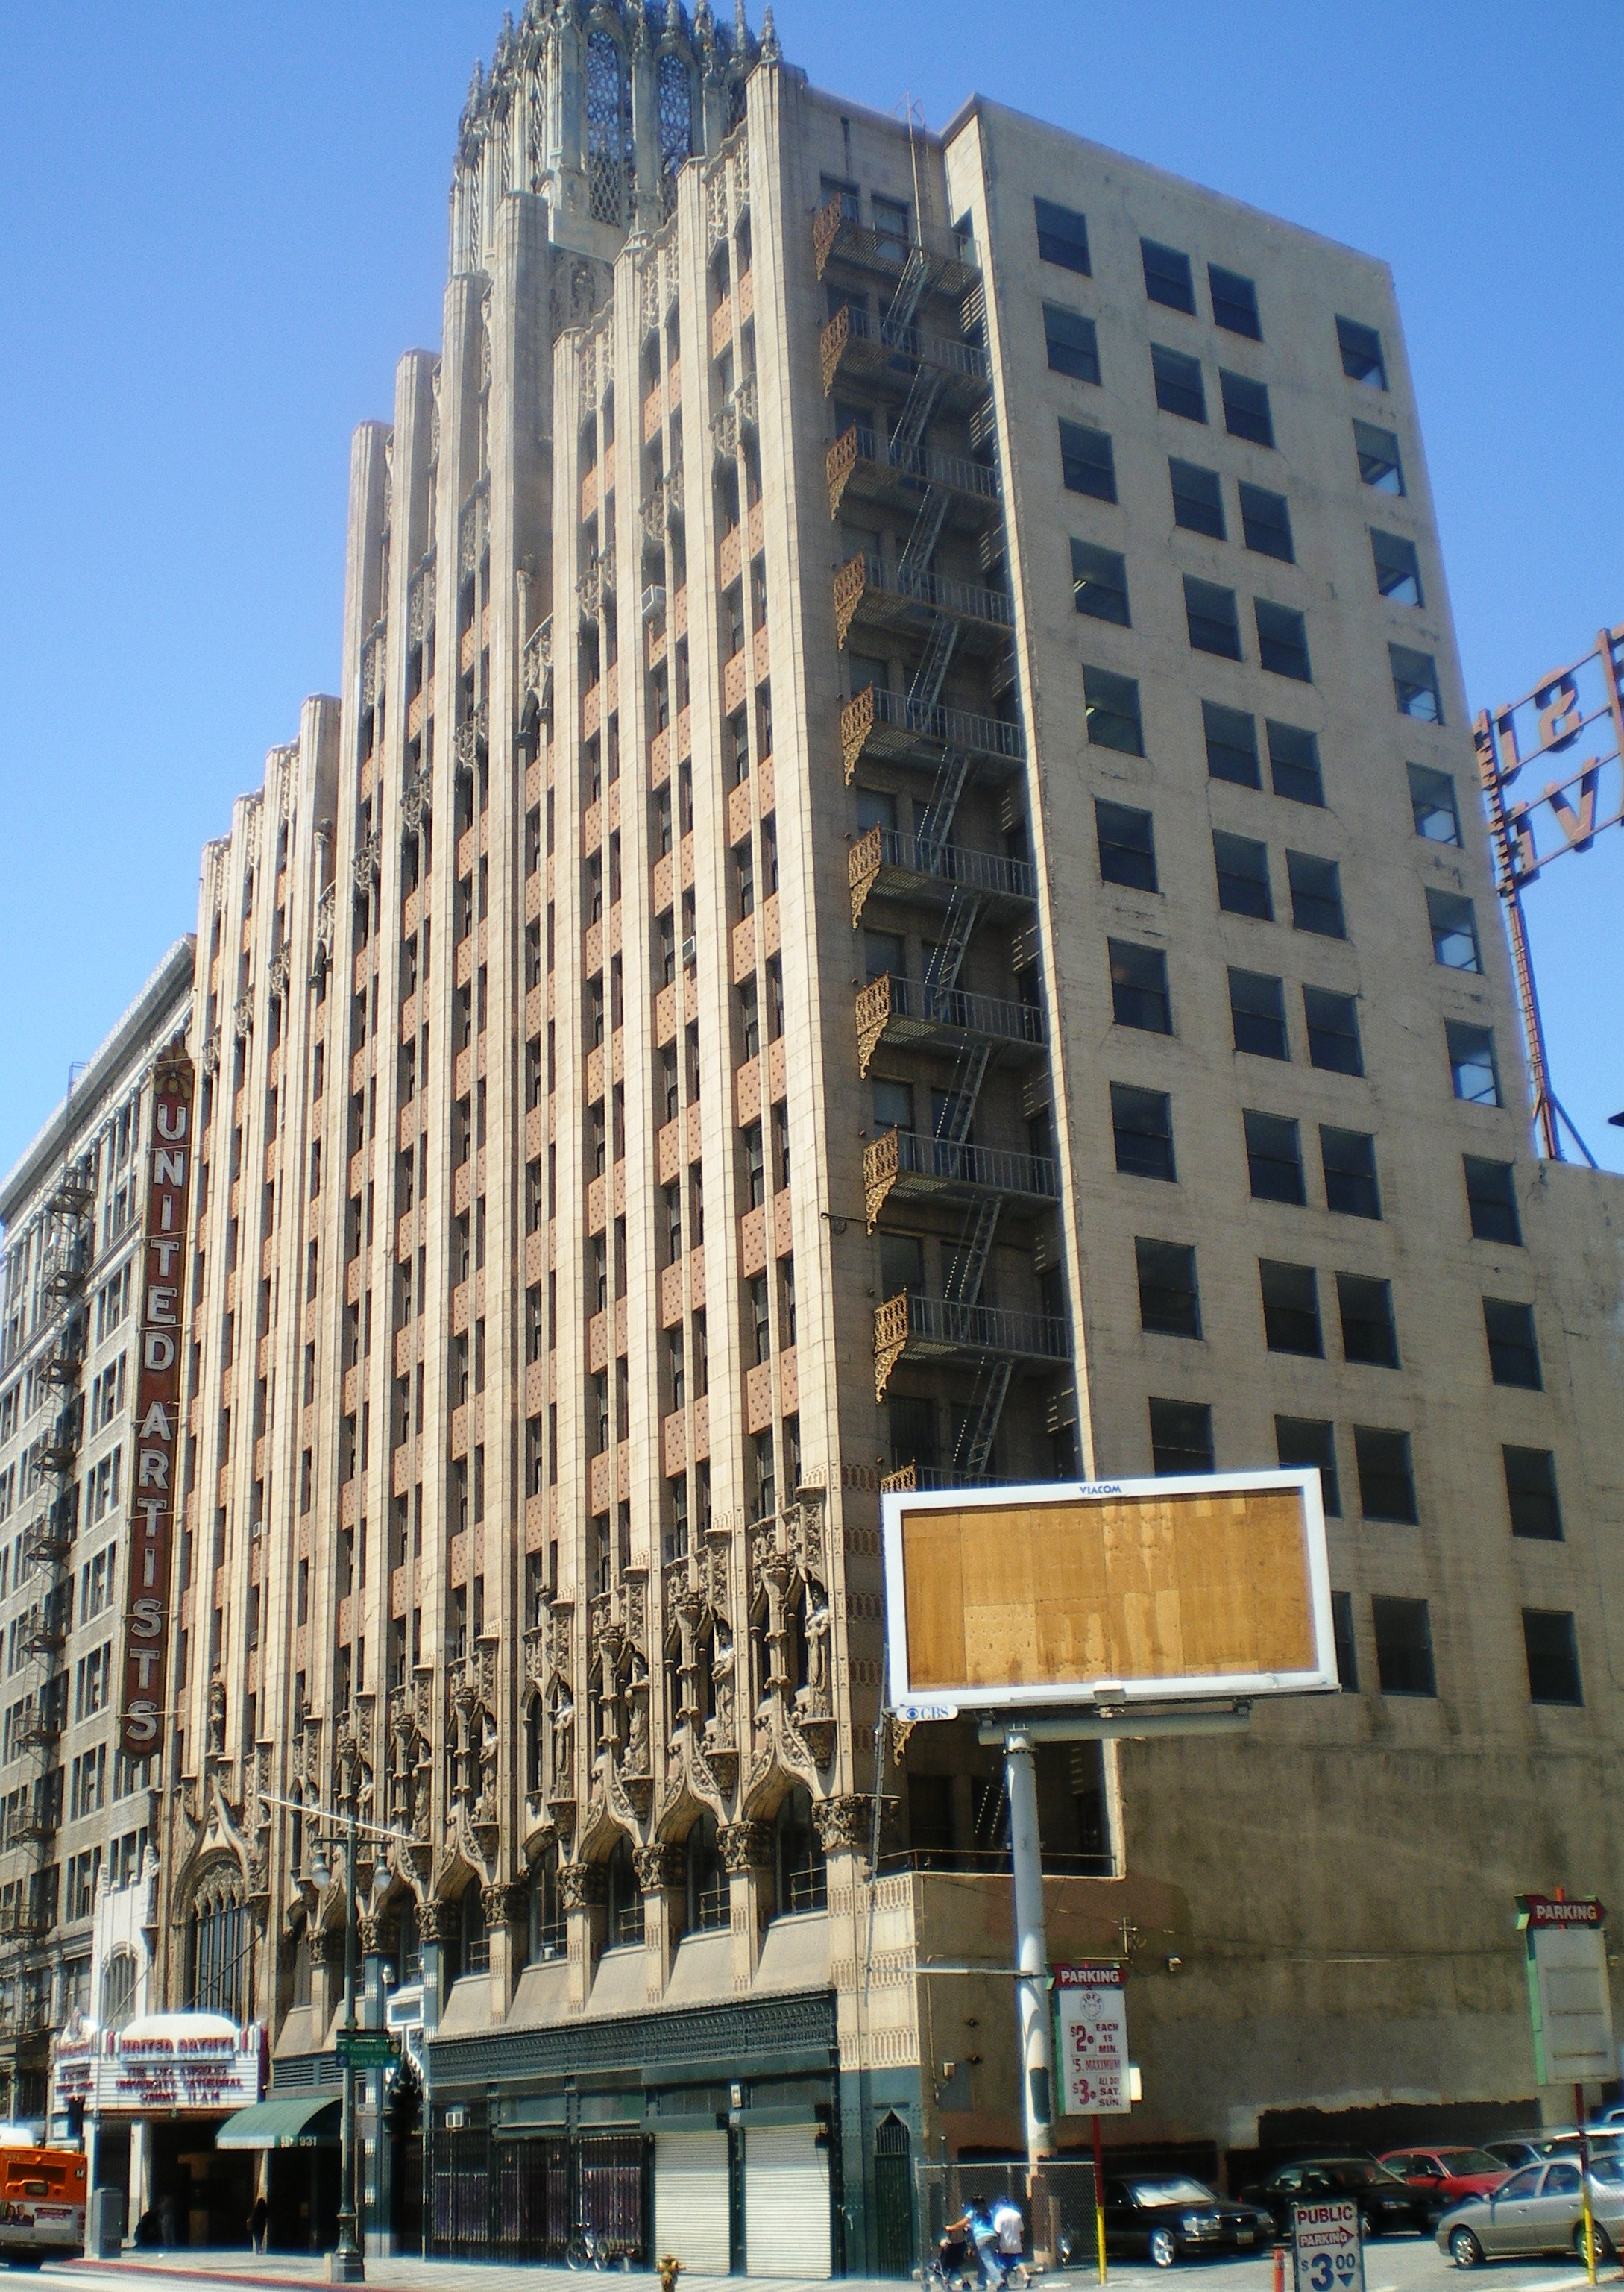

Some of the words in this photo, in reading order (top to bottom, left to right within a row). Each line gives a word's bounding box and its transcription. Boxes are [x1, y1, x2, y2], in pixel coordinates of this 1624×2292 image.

[144, 1103, 186, 1372] UNITED
[1079, 1485, 1122, 1495] VIACOM
[125, 1401, 171, 1745] ARTISTS
[921, 1706, 948, 1719] CBS
[1536, 1904, 1597, 1921] PARKING
[1060, 1969, 1121, 1984] PARKING
[1096, 2023, 1118, 2032] EACH
[1103, 2033, 1113, 2042] 15
[1086, 2059, 1121, 2071] MAXIMUM
[299, 2135, 317, 2147] 931
[1298, 2206, 1353, 2225] PUBLIC
[1300, 2232, 1348, 2247] PARKING
